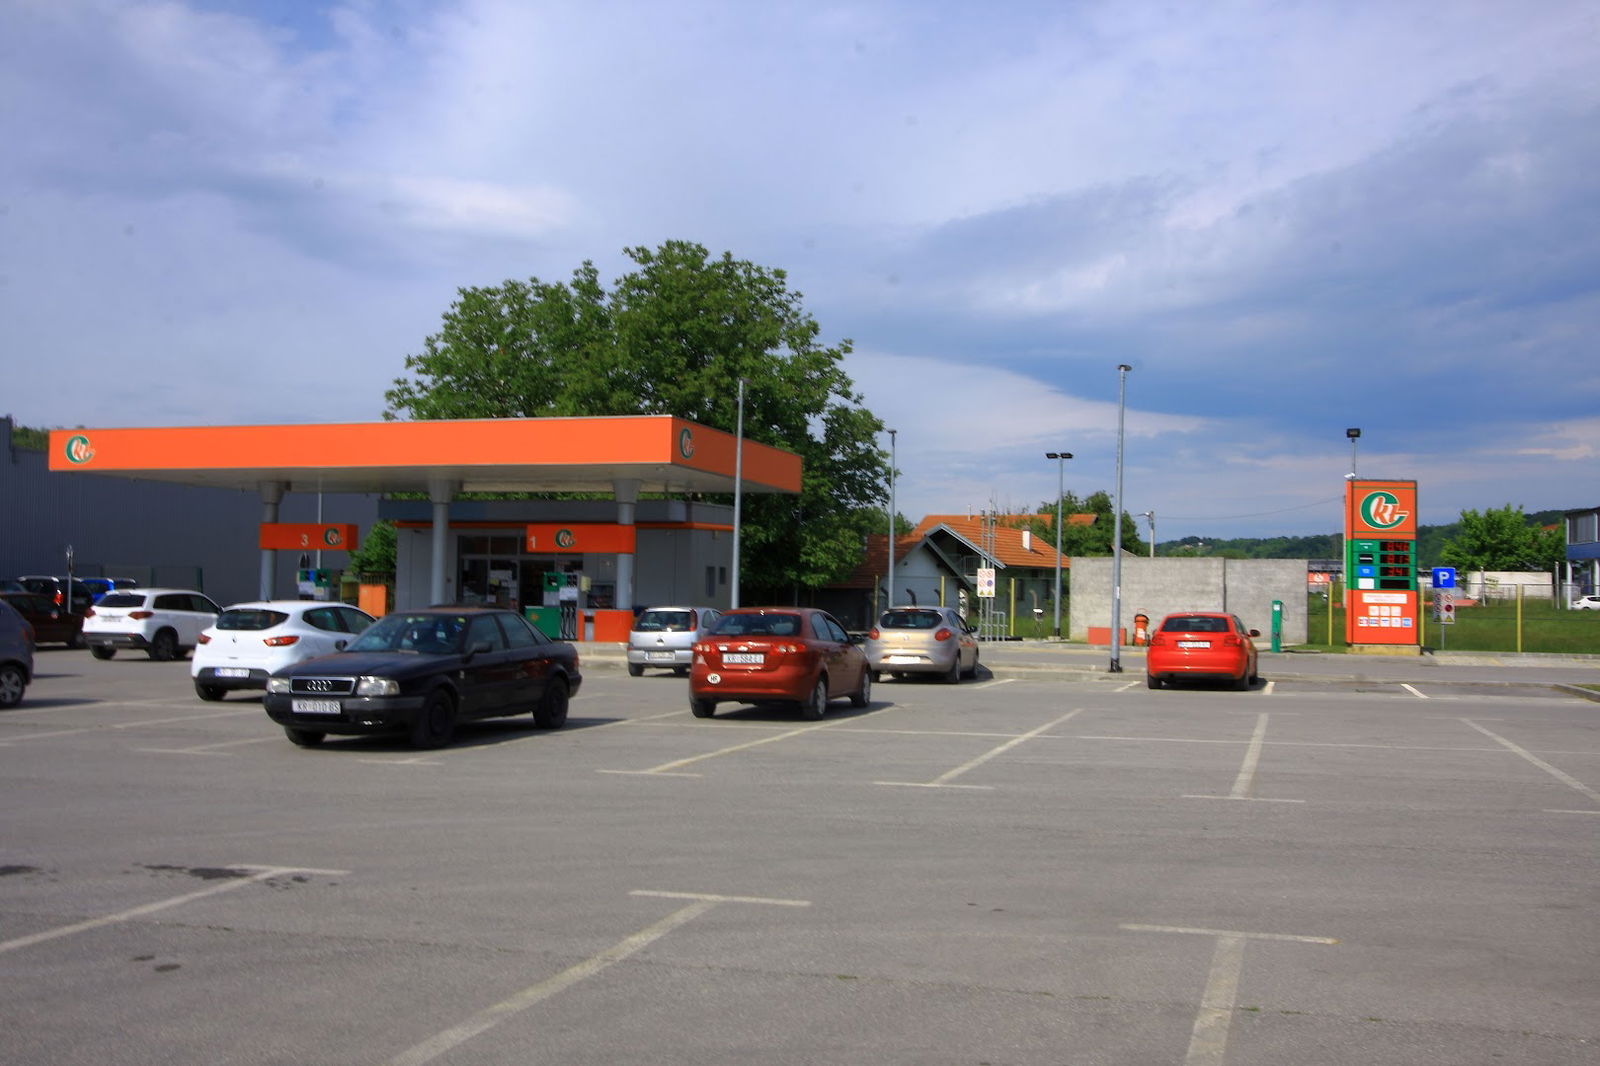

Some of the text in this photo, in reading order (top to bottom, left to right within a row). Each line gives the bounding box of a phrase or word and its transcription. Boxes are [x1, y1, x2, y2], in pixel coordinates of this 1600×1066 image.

[301, 534, 309, 546] 3
[530, 536, 536, 549] 1
[1439, 571, 1449, 585] P
